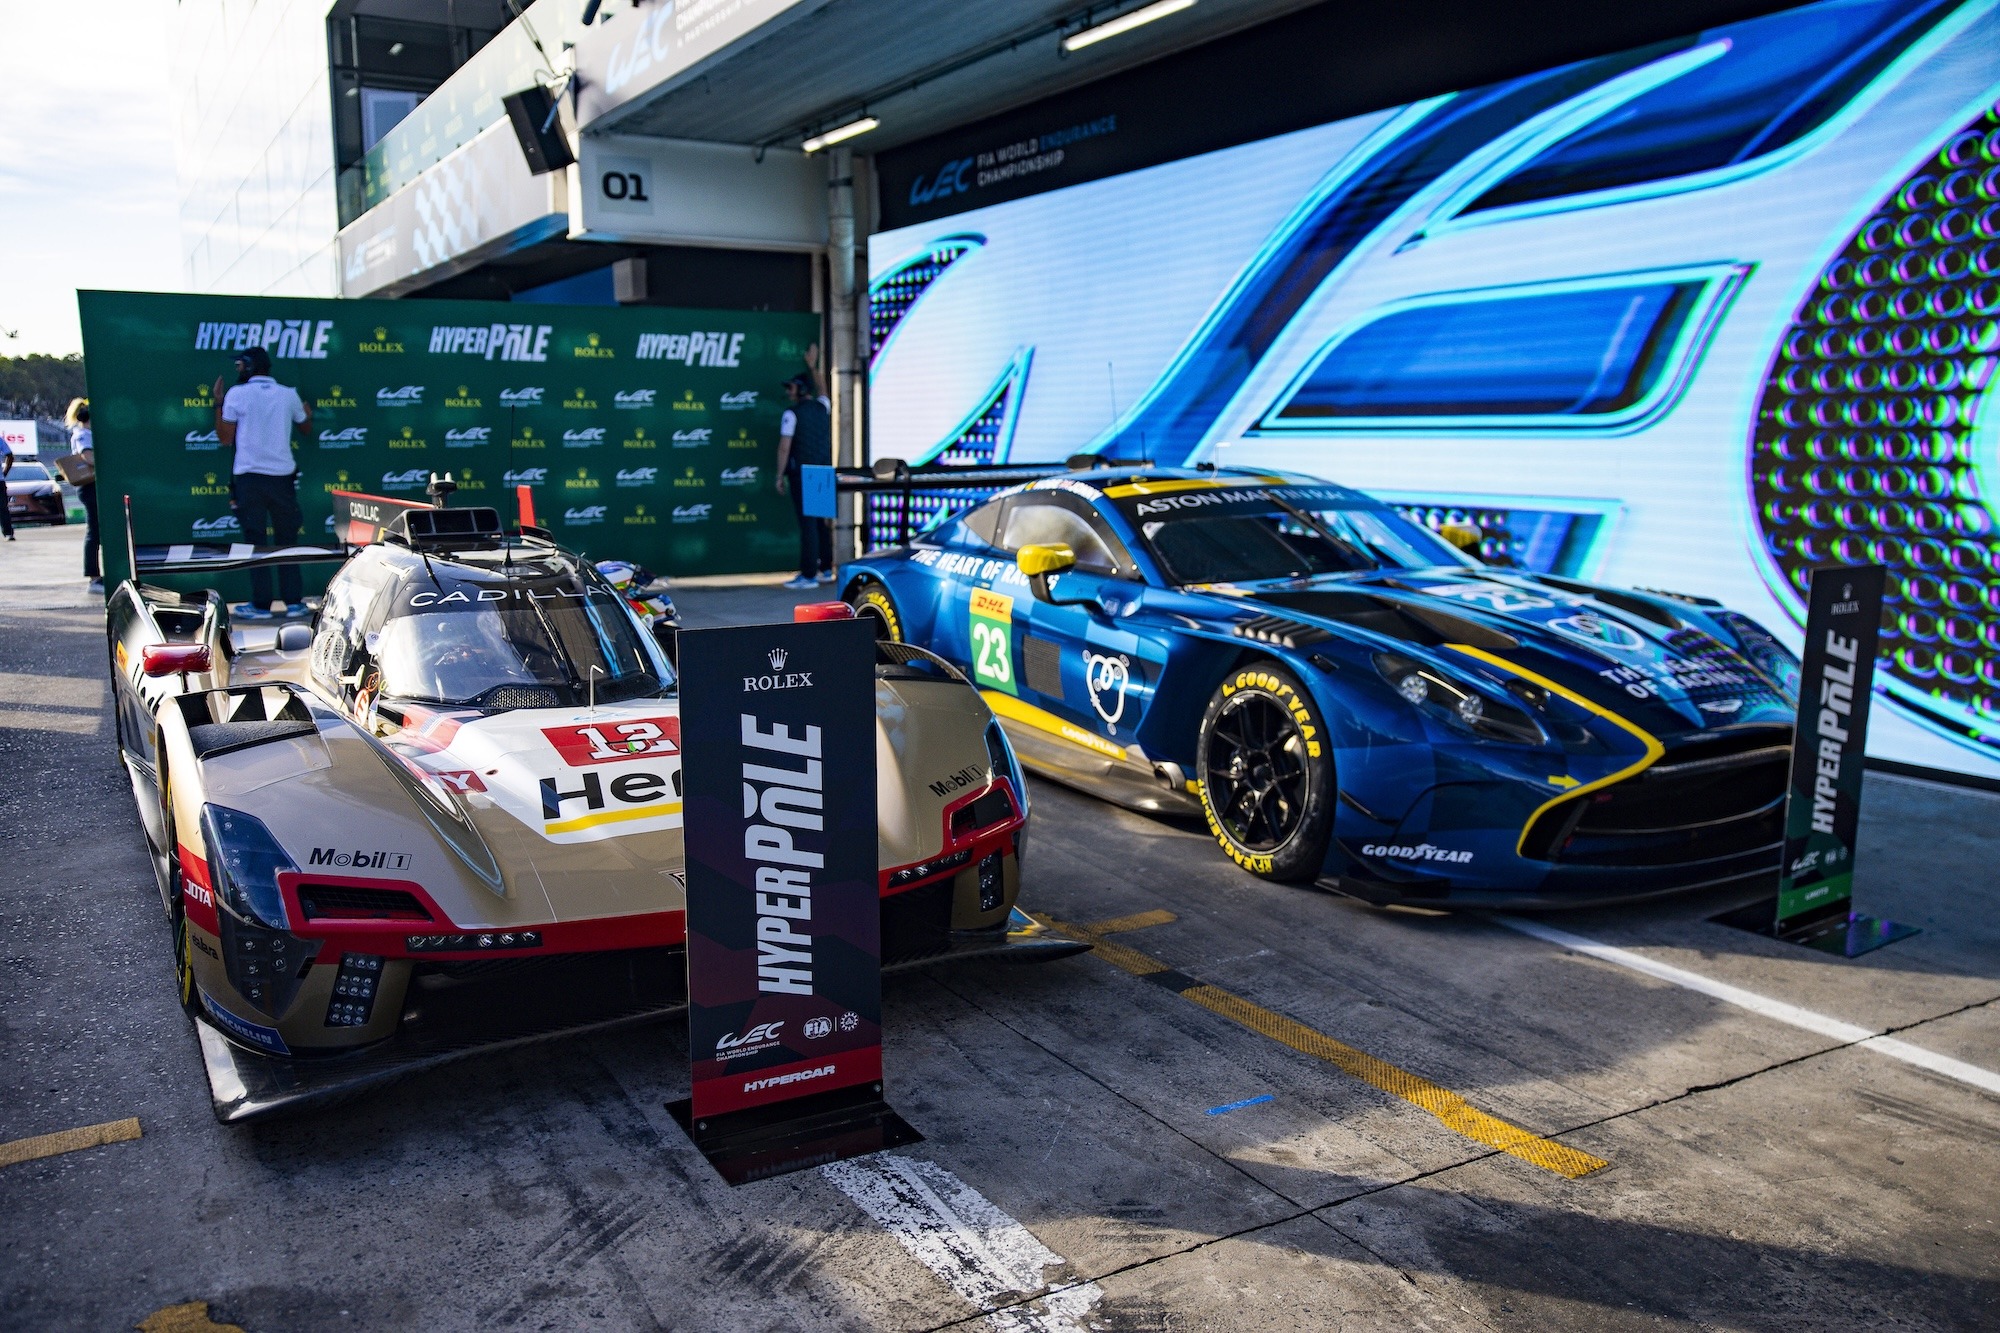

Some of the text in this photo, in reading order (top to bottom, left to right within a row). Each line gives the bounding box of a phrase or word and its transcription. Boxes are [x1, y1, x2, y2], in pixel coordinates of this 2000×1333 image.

[977, 115, 1118, 169] FIA WORLD ENDURANCE
[977, 150, 1065, 187] CHAMPIONSHIP
[602, 172, 648, 202] 01
[909, 157, 975, 206] WEC
[359, 342, 404, 353] ROLEX
[428, 323, 553, 362] HYPERPOLE
[635, 331, 745, 367] HYPERPOLE
[574, 347, 614, 358] ROLEX
[317, 398, 357, 408] ROLEX
[445, 398, 482, 408] ROLEX
[563, 400, 598, 409] ROLEX
[673, 401, 706, 411] ROLEX
[389, 439, 427, 449] ROLEX
[511, 439, 546, 448] ROLEX
[623, 439, 656, 448] ROLEX
[728, 439, 757, 448] ROLEX
[324, 482, 363, 492] ROLEX
[456, 480, 486, 490] OLEX
[565, 479, 600, 488] ROLEX
[674, 478, 705, 487] ROLEX
[350, 502, 380, 522] CADILLAC
[1136, 492, 1222, 517] ASTON
[623, 516, 656, 525] ROLEX
[726, 514, 757, 522] ROLEX
[910, 550, 1060, 591] THE HEART OF RACG
[976, 596, 1005, 614] DHL
[1831, 601, 1860, 616] ROLEX
[973, 622, 1011, 683] 23
[743, 672, 813, 692] ROLEX
[1811, 629, 1859, 835] HYPERPOLE
[928, 769, 975, 798] Mobil
[308, 847, 387, 869] Mobil
[740, 713, 824, 996] HYPERPOLE
[1361, 842, 1474, 864] GOODYEAR
[184, 878, 212, 909] JOTA
[216, 1010, 273, 1045] MICHELIN
[716, 1020, 785, 1050] WEC
[716, 1050, 759, 1062] CHAMPIONSHIP
[726, 1047, 747, 1056] WORLD
[747, 1040, 780, 1052] ENDURANCE
[743, 1065, 836, 1093] HYPERCAR
